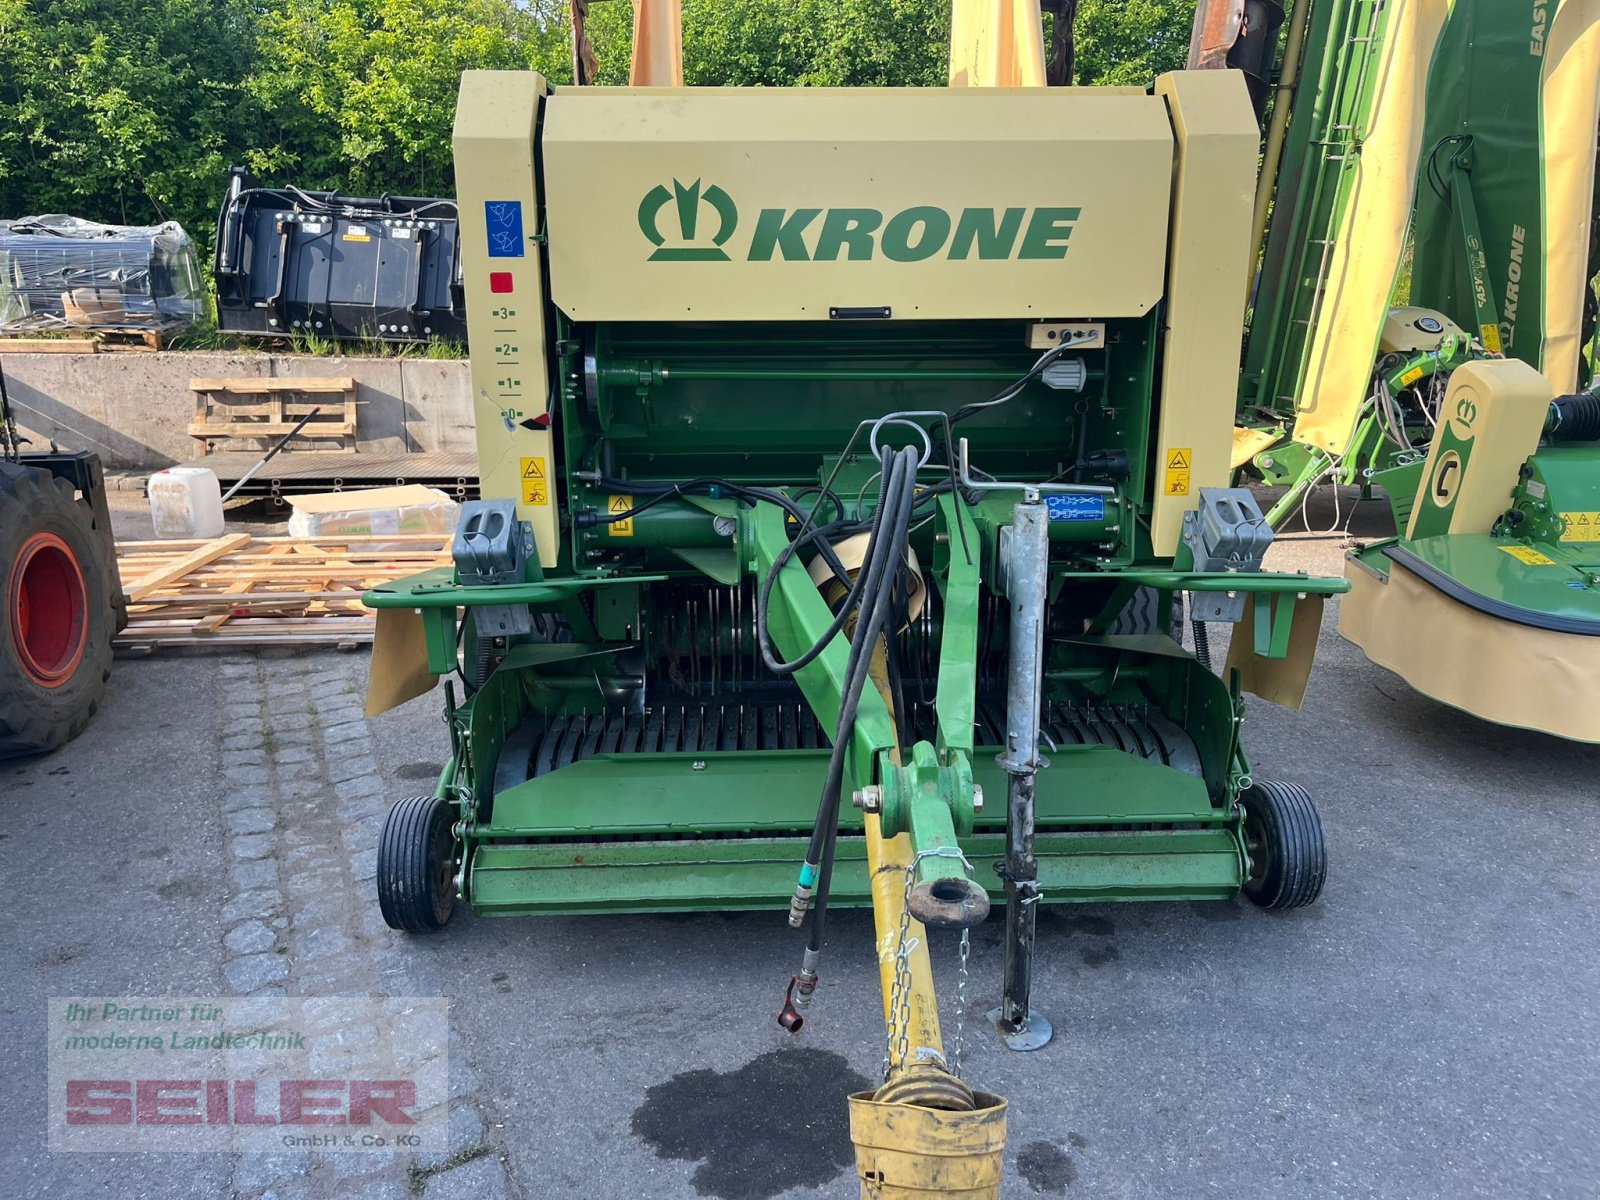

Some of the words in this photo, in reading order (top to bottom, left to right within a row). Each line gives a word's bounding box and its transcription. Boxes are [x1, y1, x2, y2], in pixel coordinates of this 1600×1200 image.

[746, 205, 1081, 263] KRONE
[1504, 224, 1526, 322] KRONE
[500, 307, 508, 320] 3
[503, 343, 511, 356] 2
[506, 377, 512, 389] 1
[508, 408, 516, 420] 0
